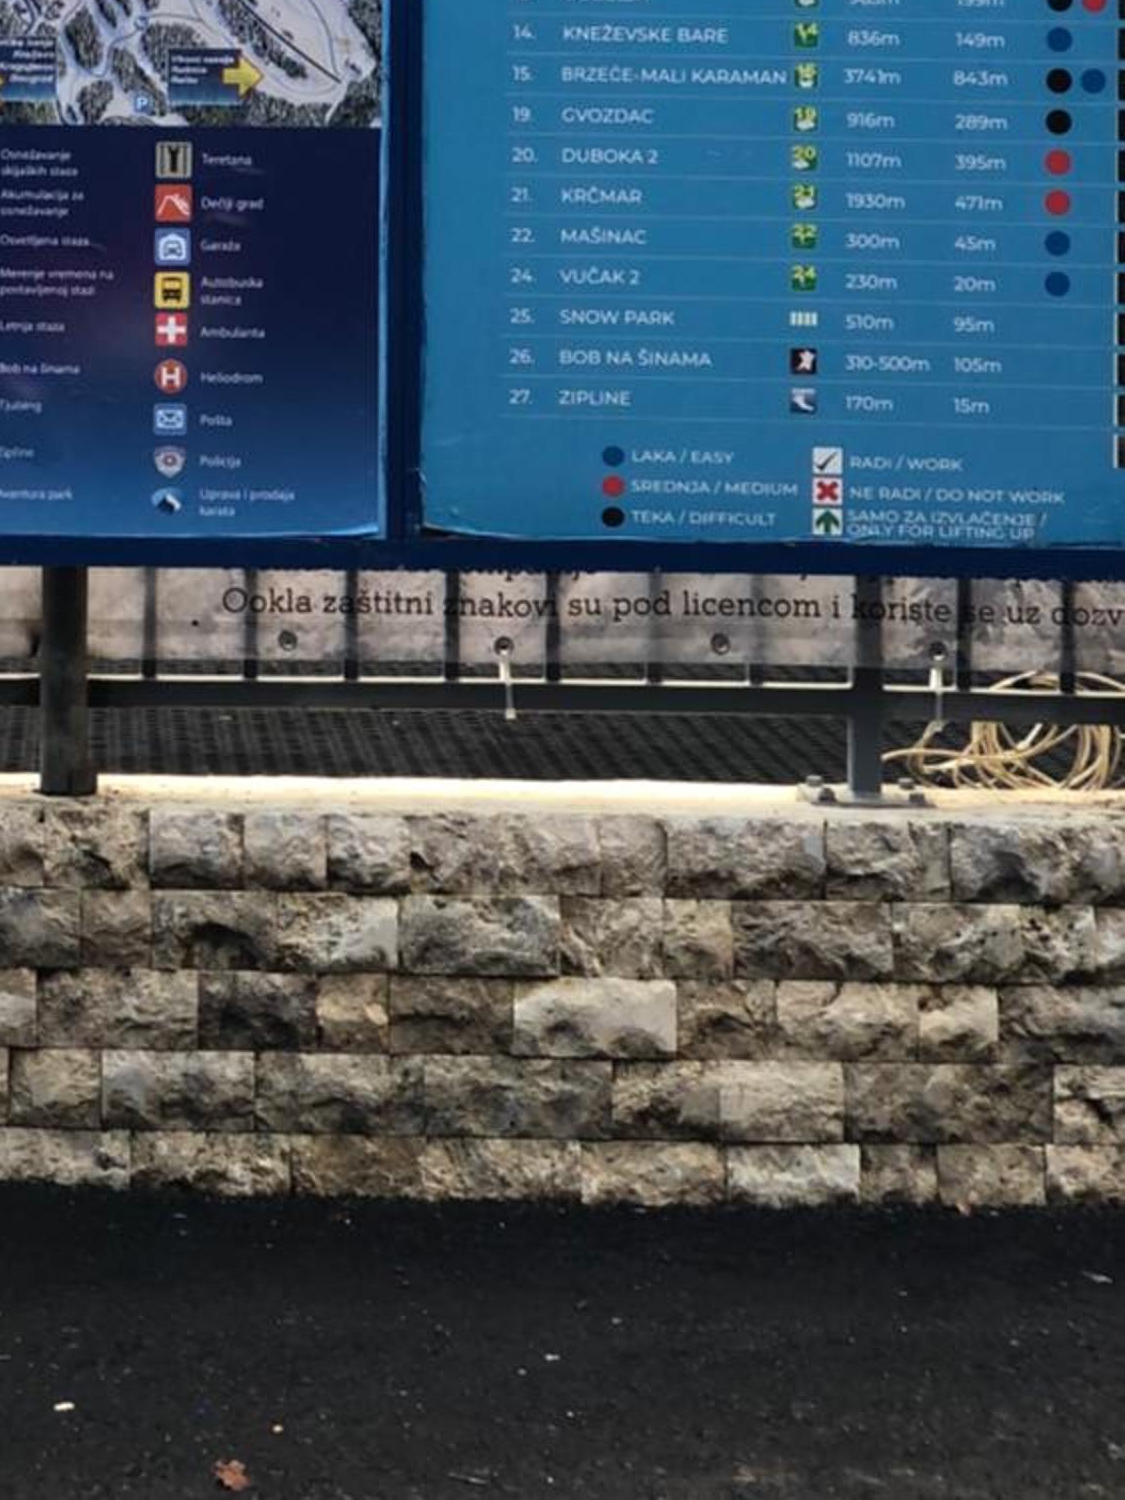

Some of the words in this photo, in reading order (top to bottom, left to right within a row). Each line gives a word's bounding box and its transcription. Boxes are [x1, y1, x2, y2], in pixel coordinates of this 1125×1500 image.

[563, 24, 670, 42] KNEŽEVSKE
[677, 28, 726, 42] BARE
[848, 30, 899, 46] 836m
[956, 33, 1005, 47] 149m
[692, 70, 787, 84] KARAMAN
[954, 71, 1007, 86] 843m
[561, 107, 653, 124] GVOZDAC
[847, 112, 894, 128] 916m
[955, 114, 1007, 130] 289m
[562, 148, 643, 164] DUBOKA
[647, 150, 657, 164] 2
[847, 152, 901, 167] 1107m
[955, 155, 1005, 170] 395m
[561, 186, 641, 204] KRČMAR
[846, 193, 905, 208] 1930m
[955, 196, 1002, 210] 471m
[561, 226, 645, 244] MAŠINAC
[847, 234, 899, 248] 300m
[955, 236, 995, 250] 45m
[559, 266, 625, 284] VUČAK
[630, 270, 639, 284] 2
[846, 274, 897, 289] 230m
[955, 276, 995, 292] 20m
[560, 309, 619, 324] SNOW
[625, 310, 674, 324] PARK
[846, 314, 893, 329] 510m
[954, 316, 994, 332] 95m
[559, 350, 601, 364] BOB
[606, 351, 633, 364] NA
[638, 348, 711, 366] ŠINAMA
[847, 355, 929, 371] 310-500m
[955, 358, 1001, 372] 105m
[559, 390, 630, 406] ZIPLINE
[846, 396, 893, 410] 170m
[955, 398, 989, 413] 15m
[632, 450, 676, 463] LAKA
[691, 451, 734, 464] EASY
[849, 456, 892, 469] RADI
[907, 457, 963, 470] WORK
[631, 479, 711, 494] SREDNJA
[725, 481, 798, 495] MEDIUM
[850, 486, 874, 500] NE
[879, 487, 921, 500] RADI
[936, 488, 964, 502] DO
[967, 489, 1003, 502] NOT
[1009, 491, 1065, 504] WORK
[631, 510, 675, 523] TEKA
[689, 511, 776, 526] DIFFICULT
[847, 509, 899, 523] SAMO
[905, 511, 927, 524] ZA
[931, 510, 1035, 527] IZVLAČENJE
[847, 523, 892, 536] ONLY
[899, 524, 933, 537] FOR
[939, 525, 1004, 540] LIFTING
[1011, 528, 1035, 540] UP
[222, 587, 312, 613] Ookla
[323, 585, 433, 615] zaštitni
[567, 597, 601, 616] su
[613, 589, 671, 621] pod
[683, 590, 820, 618] licencom
[832, 595, 840, 619] i
[1006, 603, 1041, 624] uz
